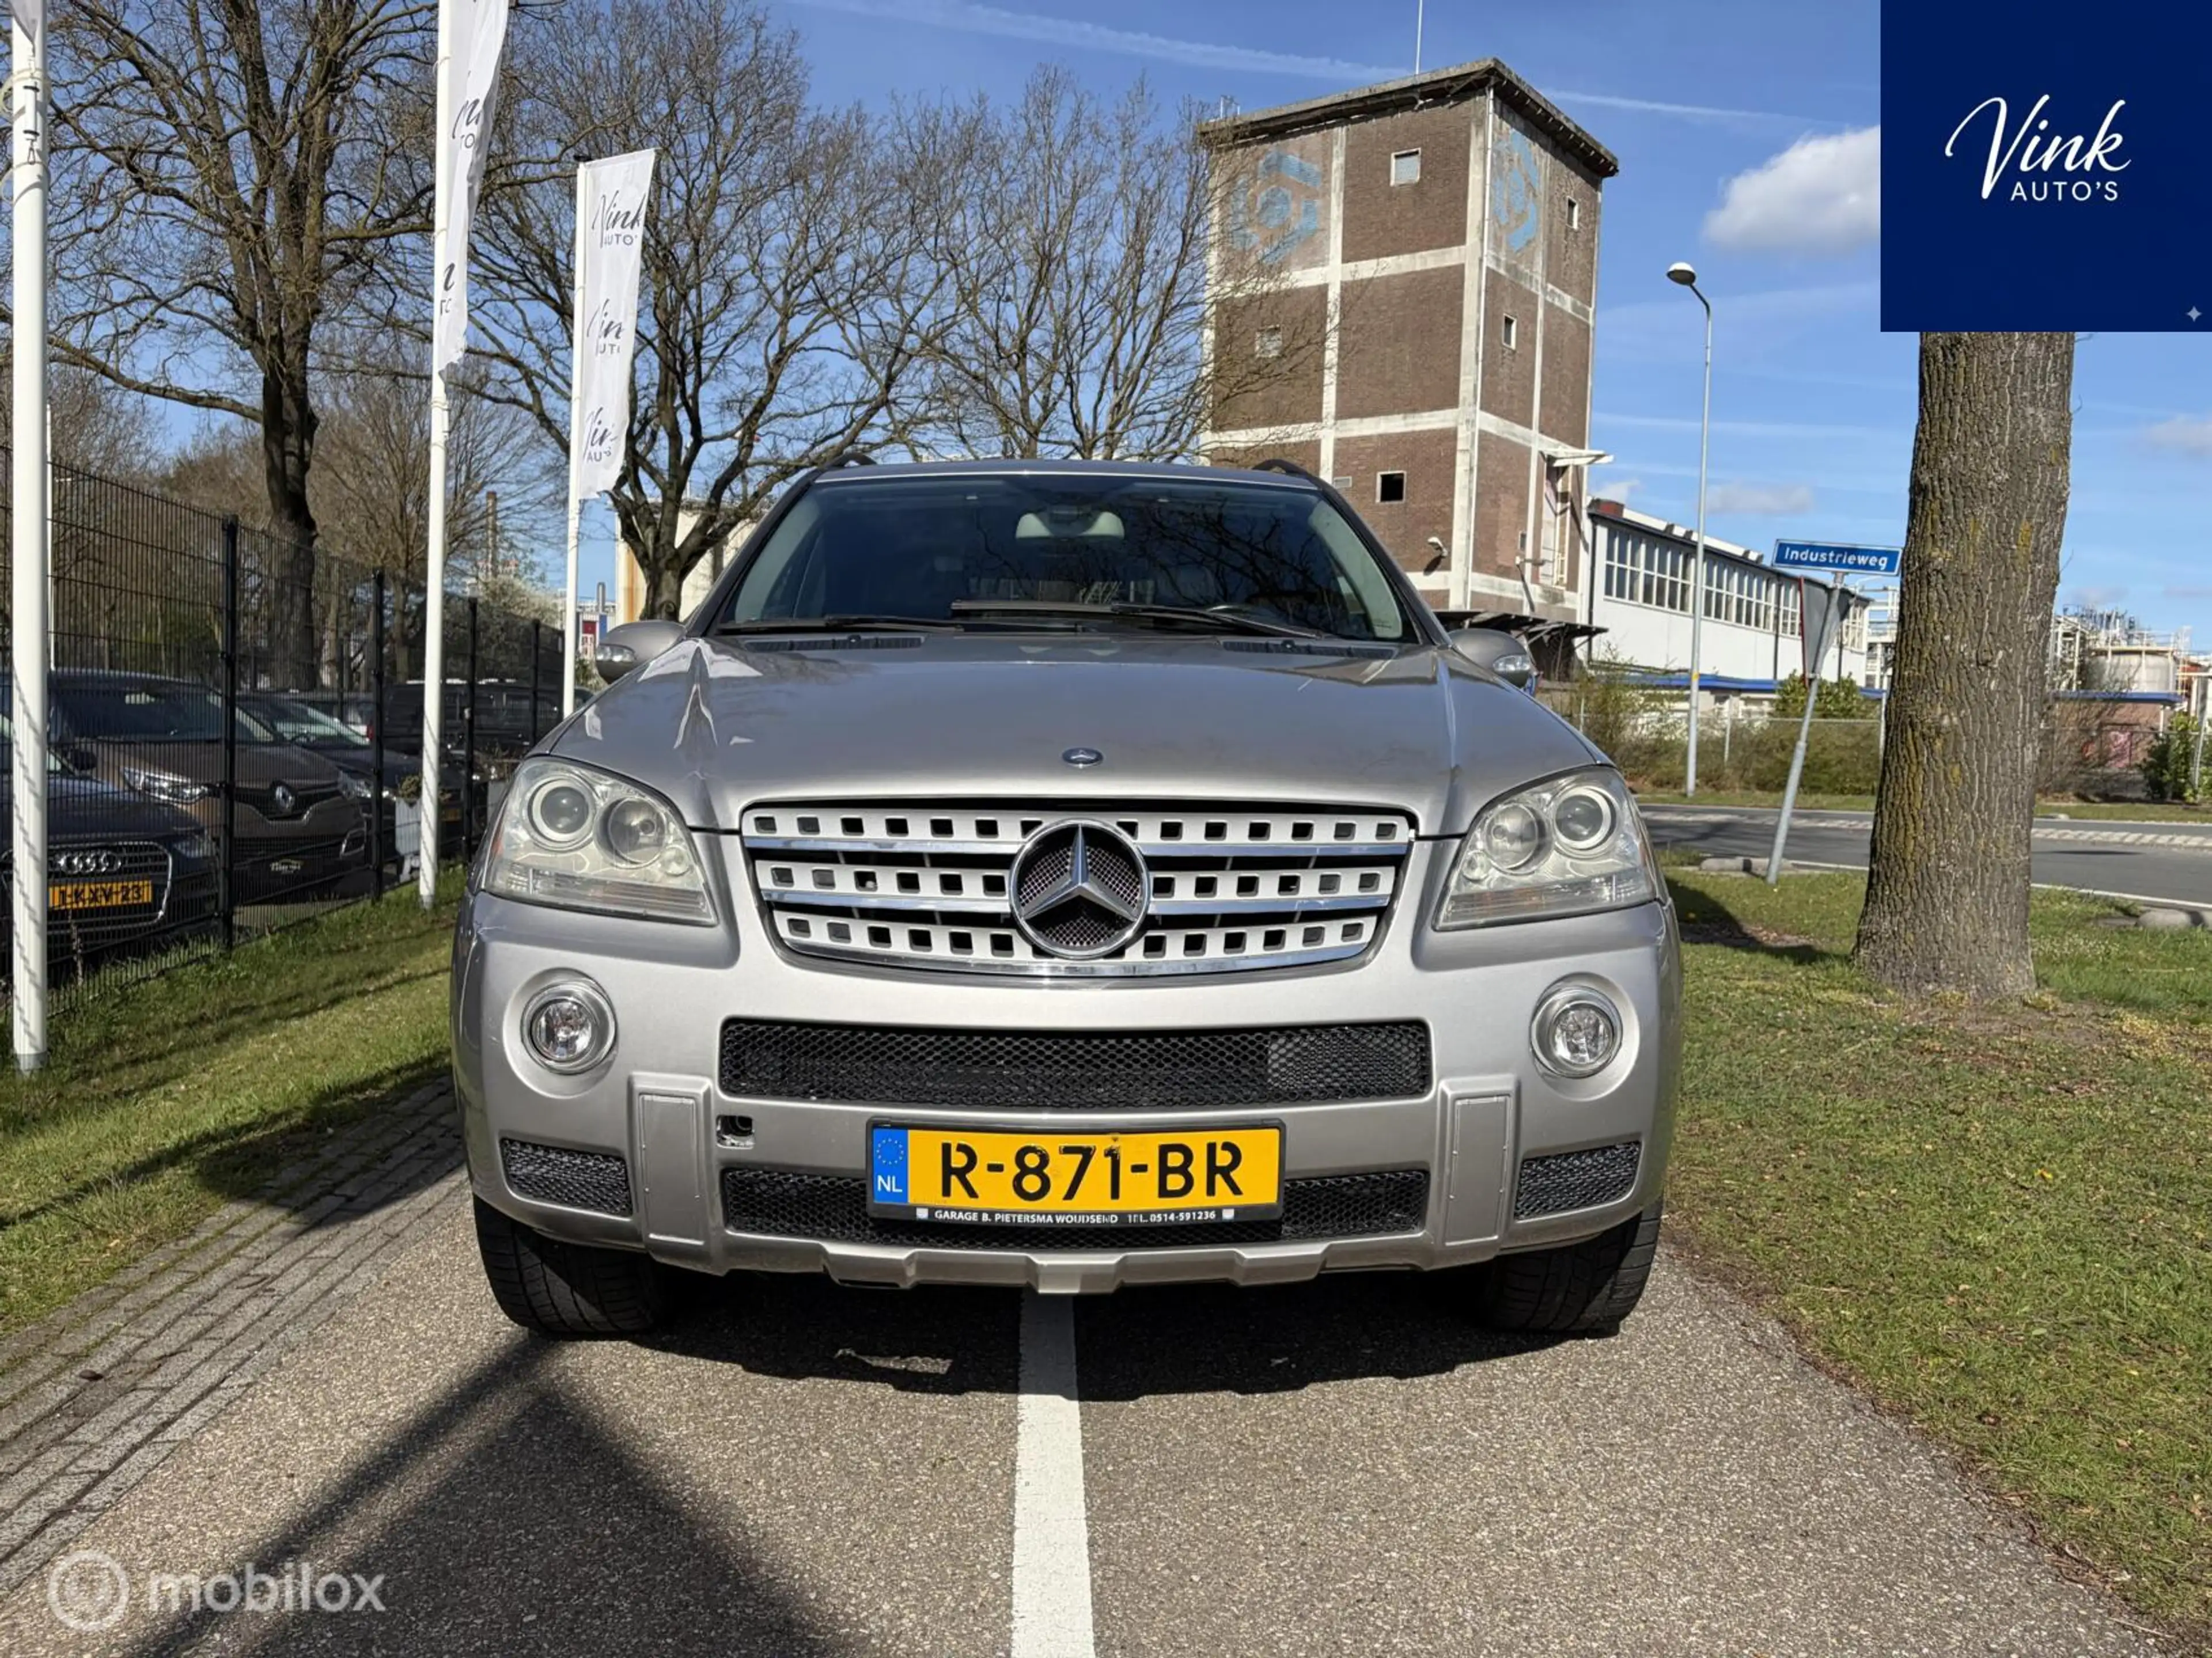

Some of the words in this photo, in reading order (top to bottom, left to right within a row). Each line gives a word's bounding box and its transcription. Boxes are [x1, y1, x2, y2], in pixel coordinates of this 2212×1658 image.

[1784, 547, 1888, 570] Industrieweg
[941, 1141, 1244, 1202] R-871-BR
[877, 1175, 903, 1193] NL
[934, 1209, 978, 1221] GARAGE
[982, 1213, 991, 1223] B.
[995, 1213, 1054, 1224] PIETERSMA
[1149, 1210, 1217, 1223] 0514-591236
